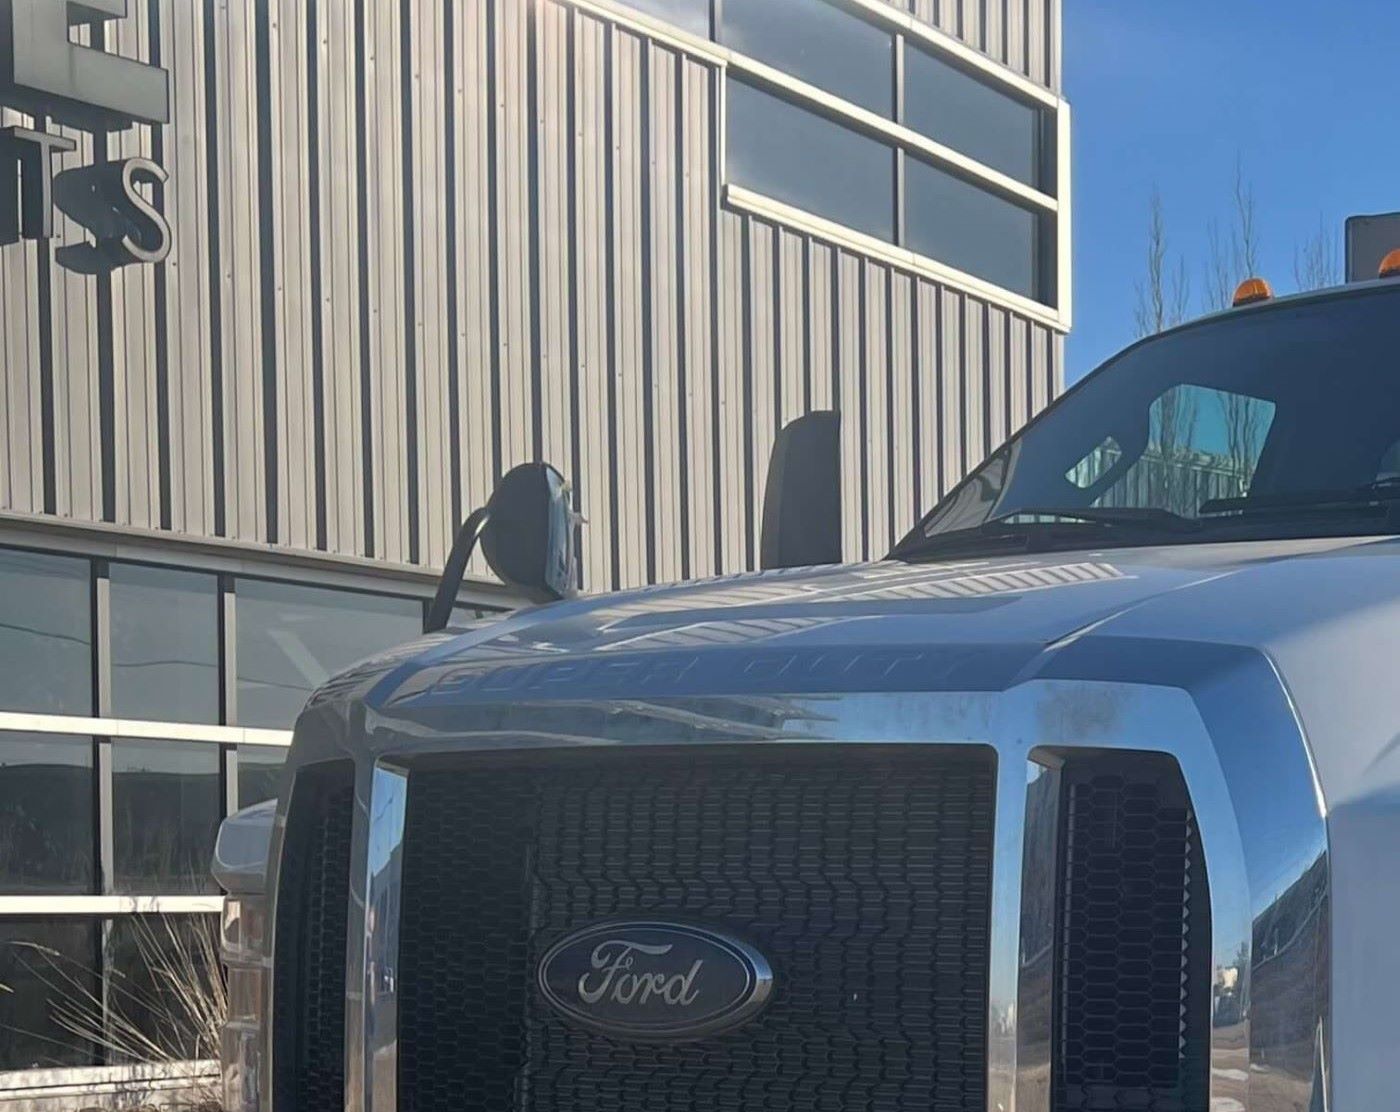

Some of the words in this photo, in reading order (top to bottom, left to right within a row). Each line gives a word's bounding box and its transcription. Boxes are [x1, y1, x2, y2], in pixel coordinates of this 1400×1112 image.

[428, 655, 700, 695] SUPER
[732, 650, 985, 684] DUTY
[578, 939, 703, 1005] Ford
